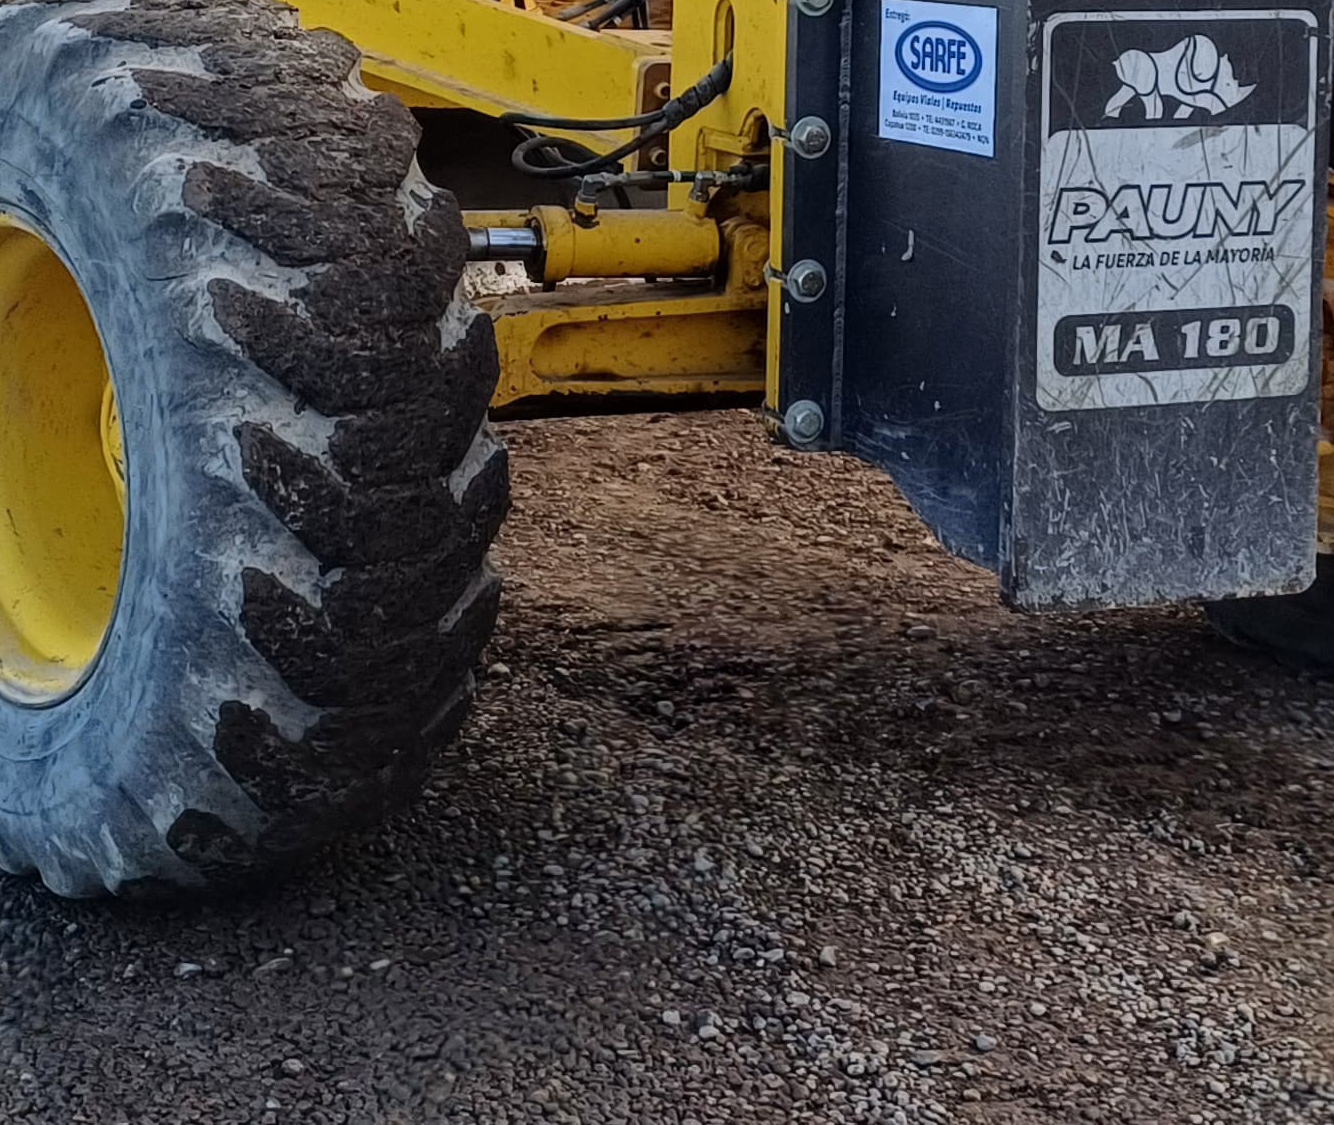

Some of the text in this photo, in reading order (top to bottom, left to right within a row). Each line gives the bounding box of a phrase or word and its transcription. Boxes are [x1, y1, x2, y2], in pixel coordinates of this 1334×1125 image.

[910, 35, 967, 76] SARFE
[1047, 179, 1306, 244] PAUNY
[1072, 254, 1091, 270] LA
[1095, 252, 1155, 269] FUERZA
[1159, 251, 1180, 266] DE
[1183, 250, 1202, 266] LA
[1072, 315, 1282, 365] MA 180
